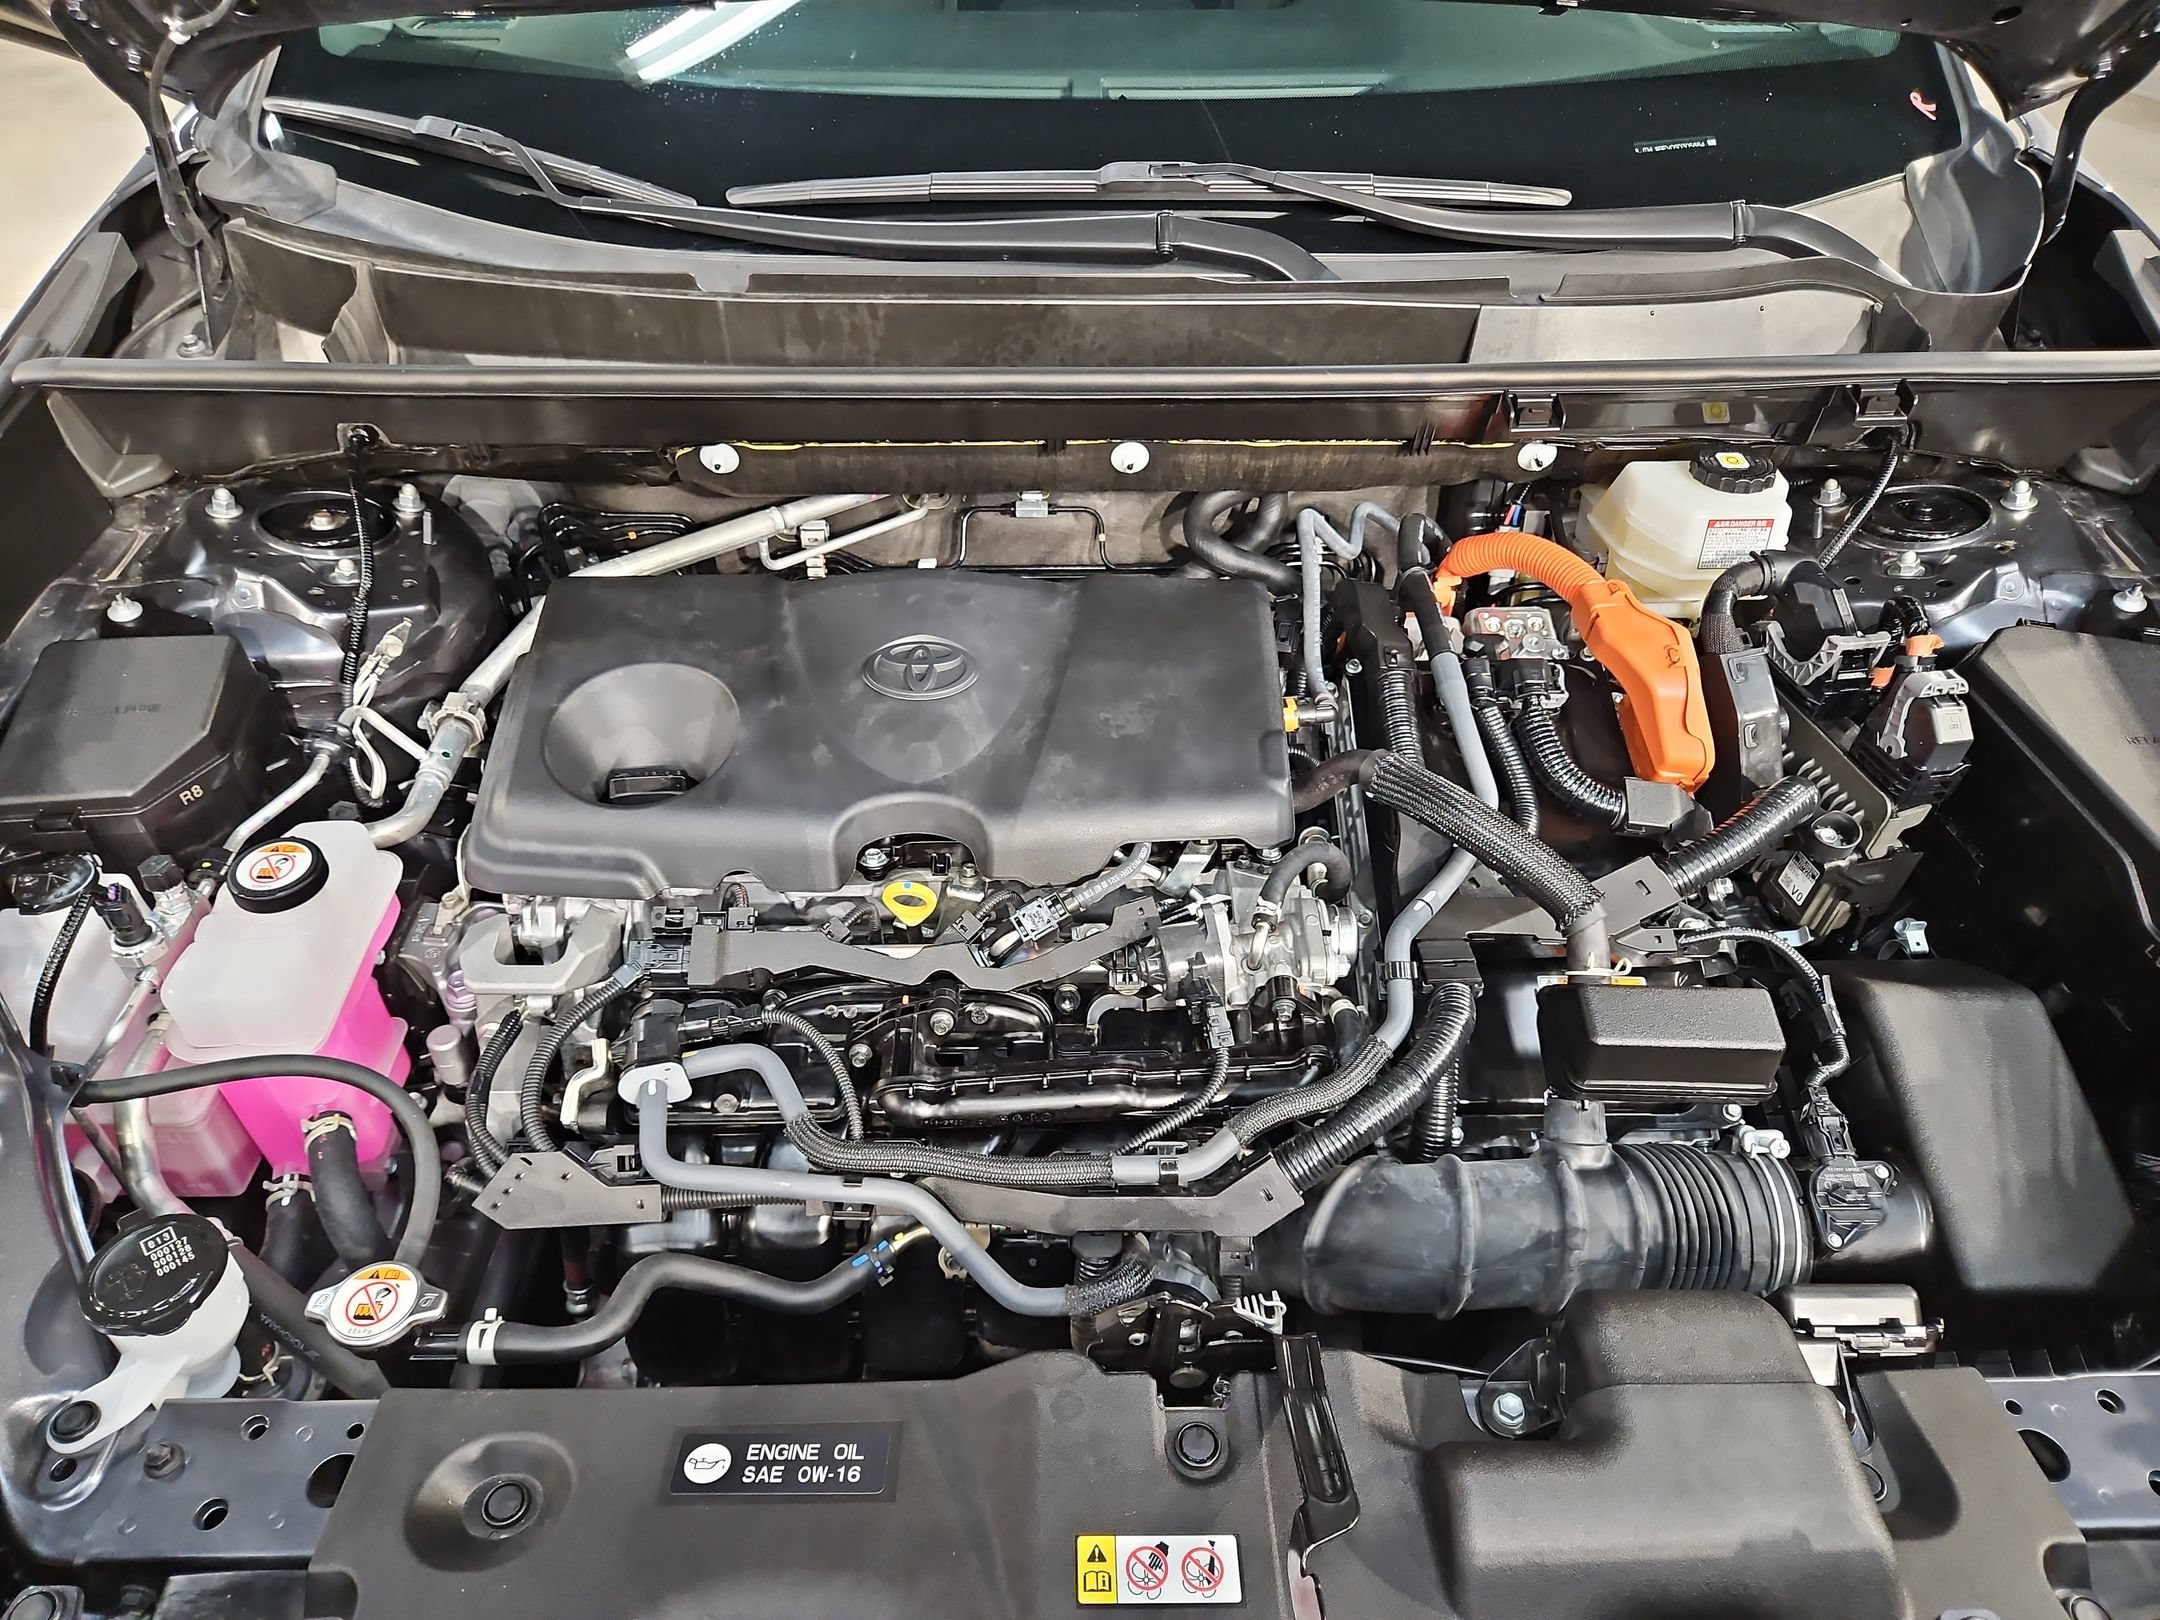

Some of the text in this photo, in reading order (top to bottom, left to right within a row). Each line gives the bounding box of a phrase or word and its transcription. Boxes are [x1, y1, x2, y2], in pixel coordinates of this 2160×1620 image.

[179, 784, 204, 806] R8
[147, 1233, 171, 1249] e13
[150, 1236, 188, 1262] 000127
[153, 1244, 192, 1269] 000128
[156, 1252, 196, 1277] 000145
[746, 1443, 865, 1461] ENGINE OIL
[741, 1465, 862, 1483] SAE 0W-16
